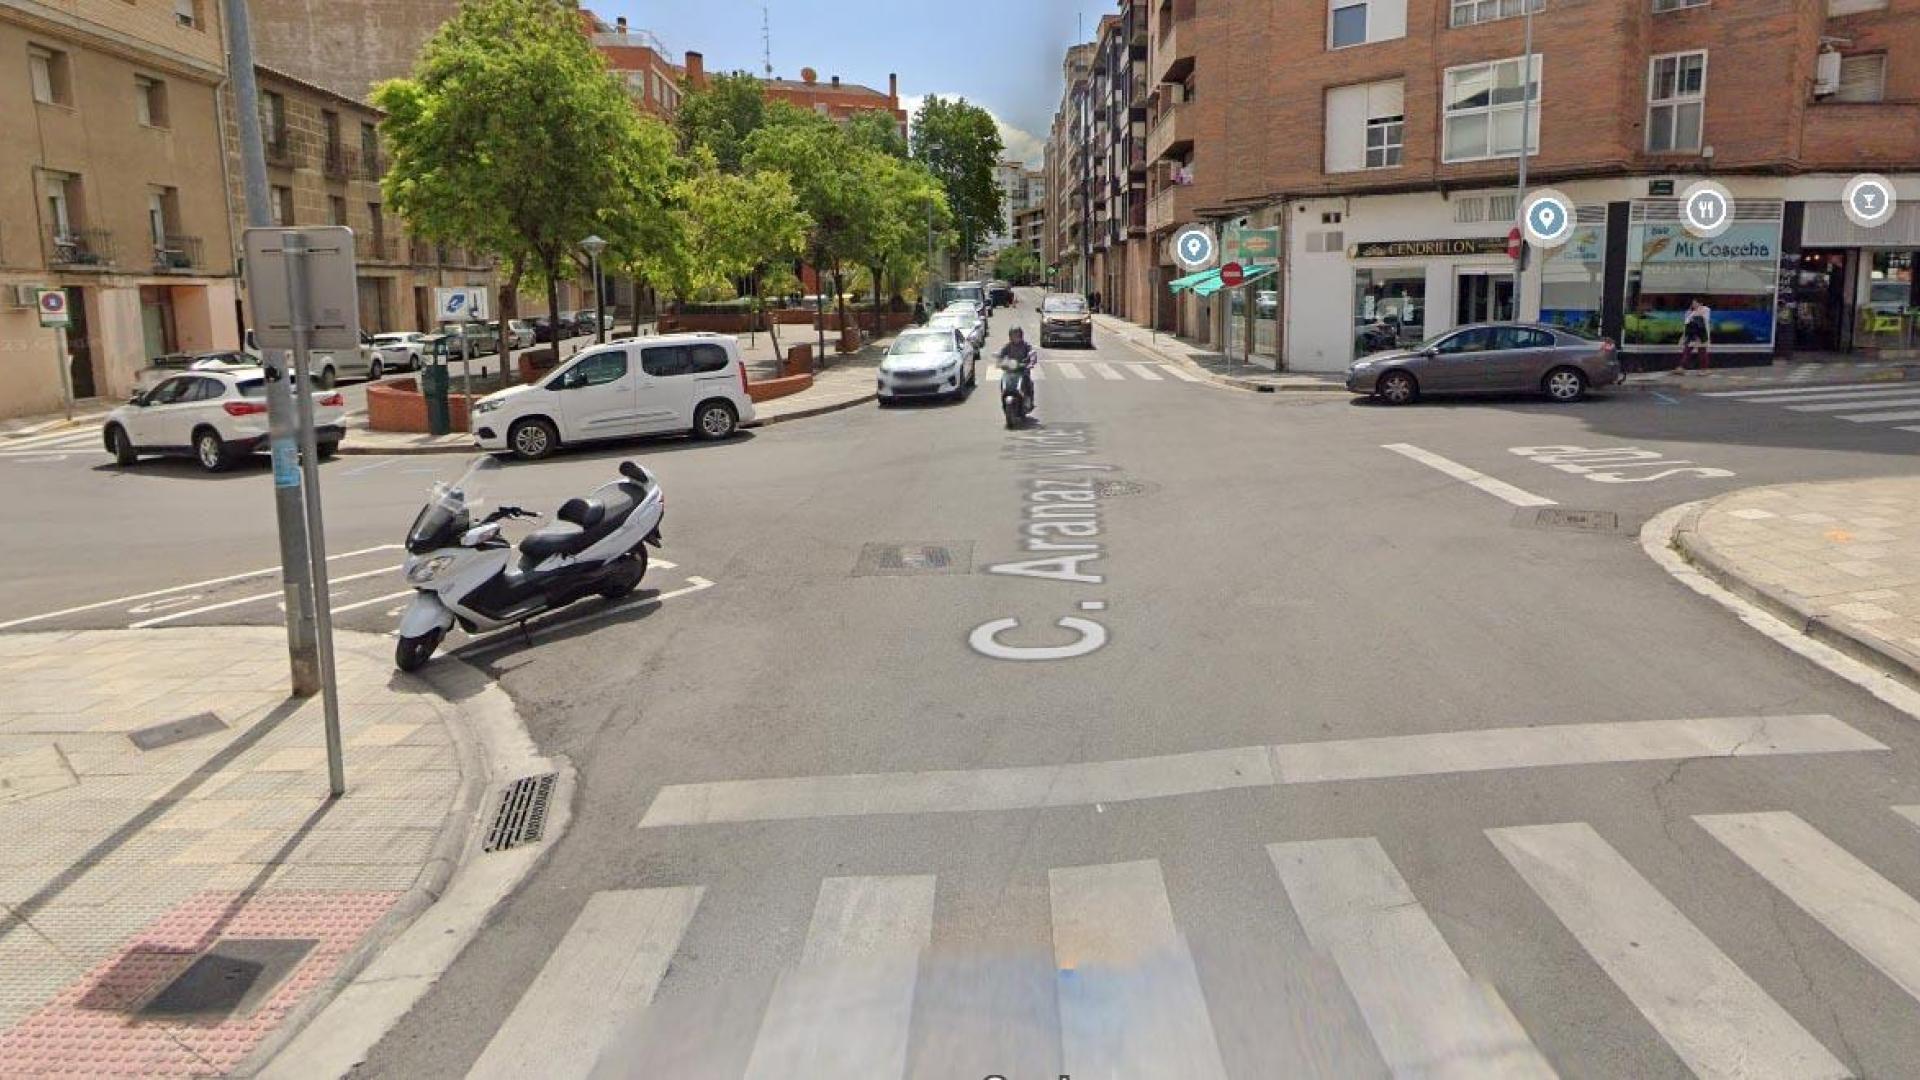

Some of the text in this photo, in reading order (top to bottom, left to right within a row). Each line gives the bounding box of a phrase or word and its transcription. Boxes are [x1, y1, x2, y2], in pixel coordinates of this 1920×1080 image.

[1390, 239, 1475, 256] CENDRILLON
[1674, 241, 1770, 257] Mi Cosecha
